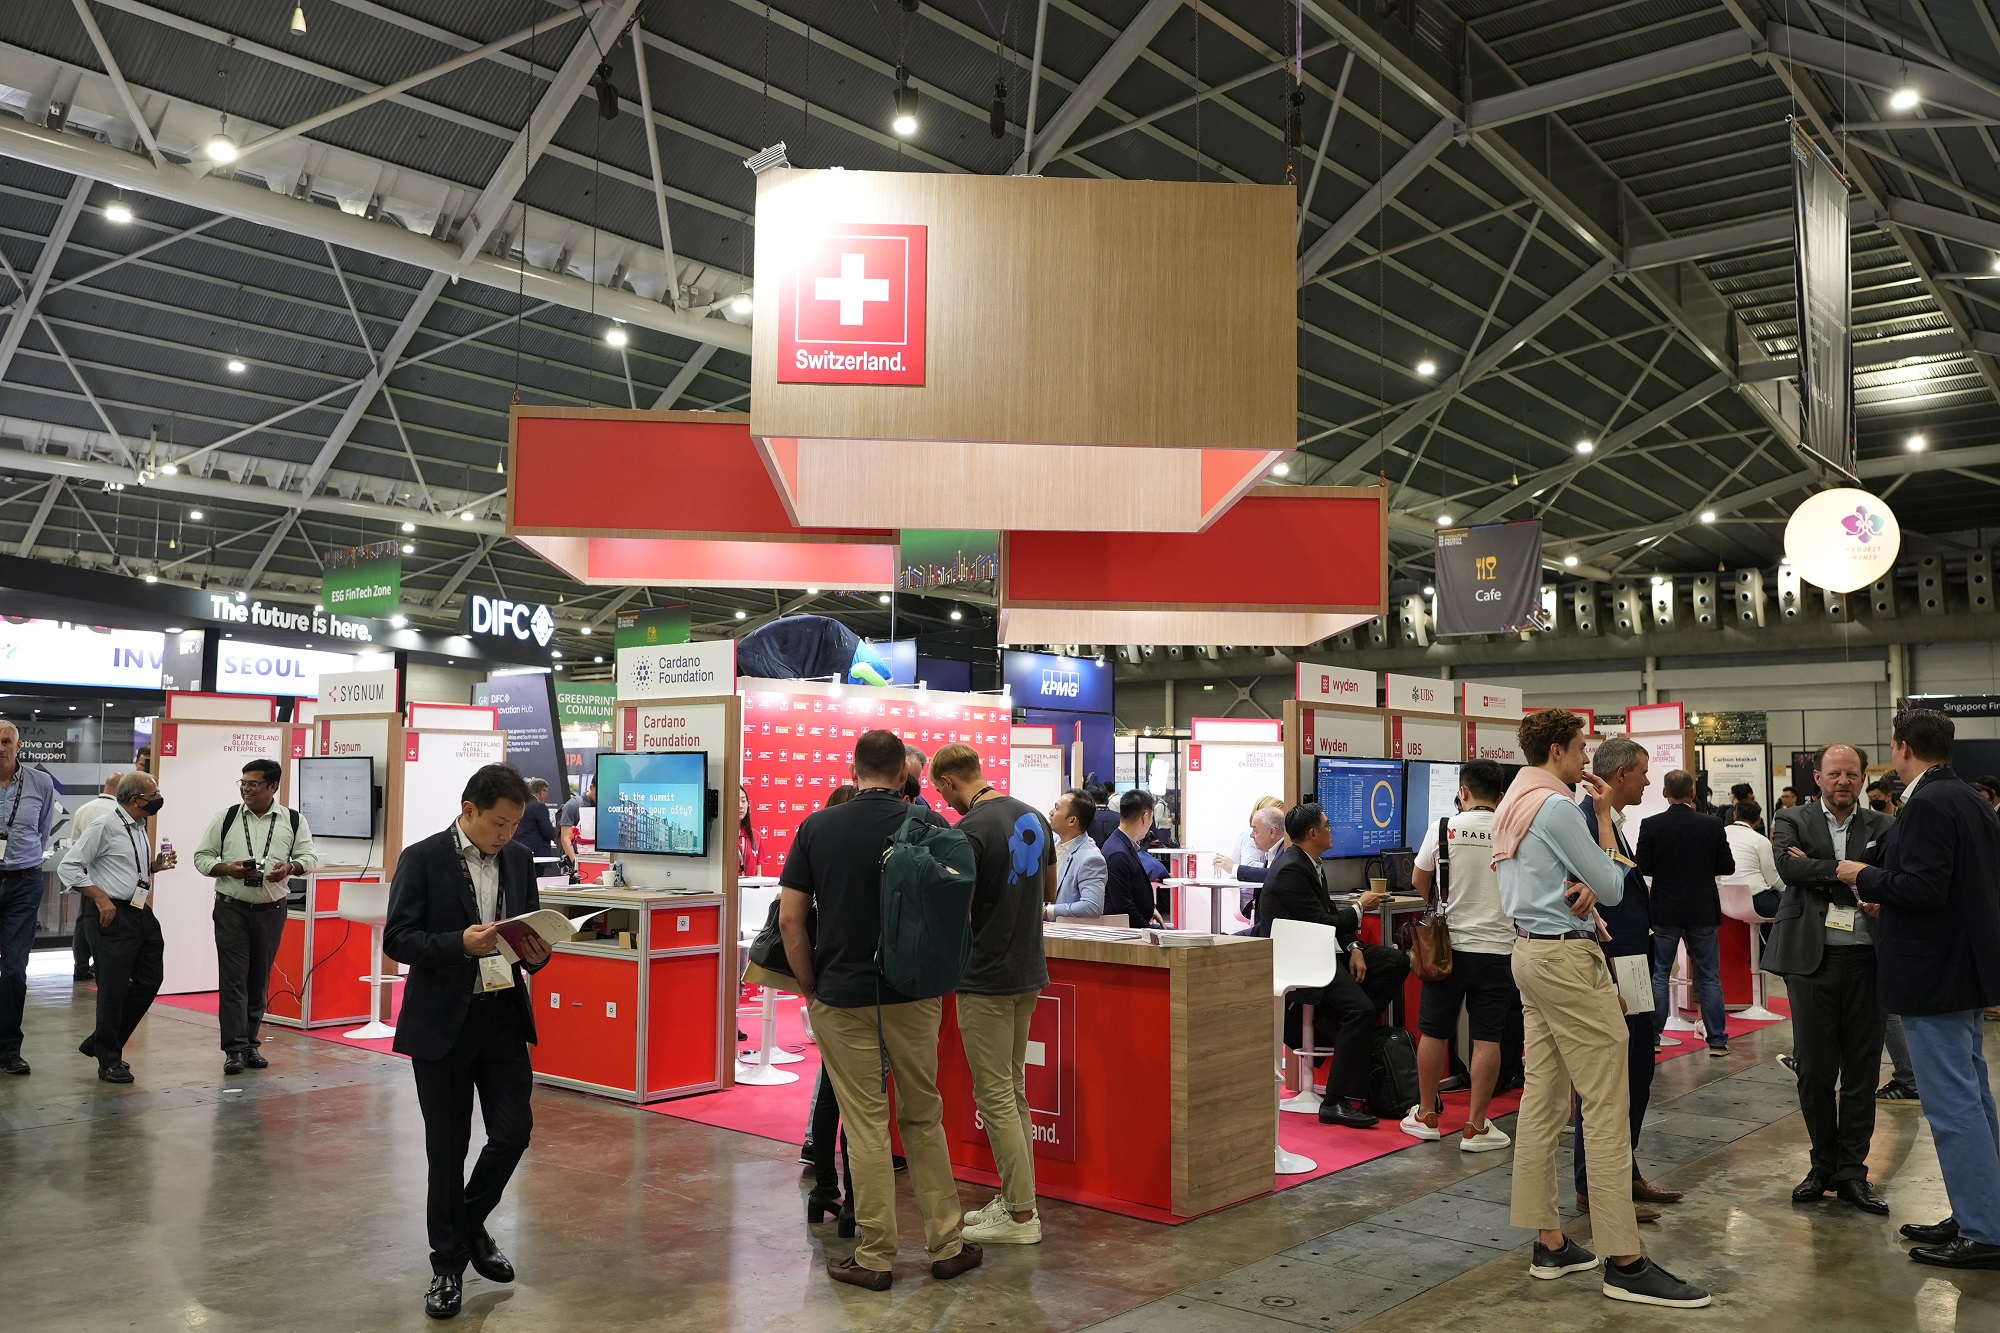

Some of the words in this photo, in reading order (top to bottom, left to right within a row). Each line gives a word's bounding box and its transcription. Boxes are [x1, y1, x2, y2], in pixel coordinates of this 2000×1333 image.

[795, 348, 907, 372] Switzerland.
[331, 591, 344, 603] ESG
[345, 586, 372, 600] FinTech
[373, 584, 392, 597] Zone
[1475, 588, 1502, 601] Cafe
[210, 595, 248, 622] The
[252, 602, 309, 632] future
[312, 610, 327, 635] is
[330, 614, 373, 641] here.
[472, 594, 531, 640] DIFC
[224, 655, 305, 678] SEOUL
[658, 655, 701, 669] Cardano
[659, 669, 714, 684] Foundation
[340, 684, 384, 702] SYGNUM
[1040, 680, 1078, 697] KPMG
[1332, 679, 1359, 694] wyden
[491, 694, 504, 703] DIFC
[1420, 688, 1434, 701] UBS
[521, 704, 533, 713] Hub
[1943, 702, 1987, 712] Singapore
[643, 715, 686, 728] Cardano
[232, 733, 279, 741] SWITZERLAND
[643, 733, 700, 747] Foundation
[44, 740, 64, 749] and
[333, 741, 361, 754] Sygnum
[1320, 737, 1347, 754] Wyden
[1407, 742, 1422, 756] UBS
[28, 750, 67, 762] happen
[1480, 747, 1515, 759] SwissCham
[619, 792, 628, 801] Is
[632, 792, 645, 801] the
[649, 792, 675, 801] summit
[608, 805, 632, 816] coming
[637, 806, 645, 814] to
[649, 806, 666, 816] your
[670, 806, 692, 816] city?
